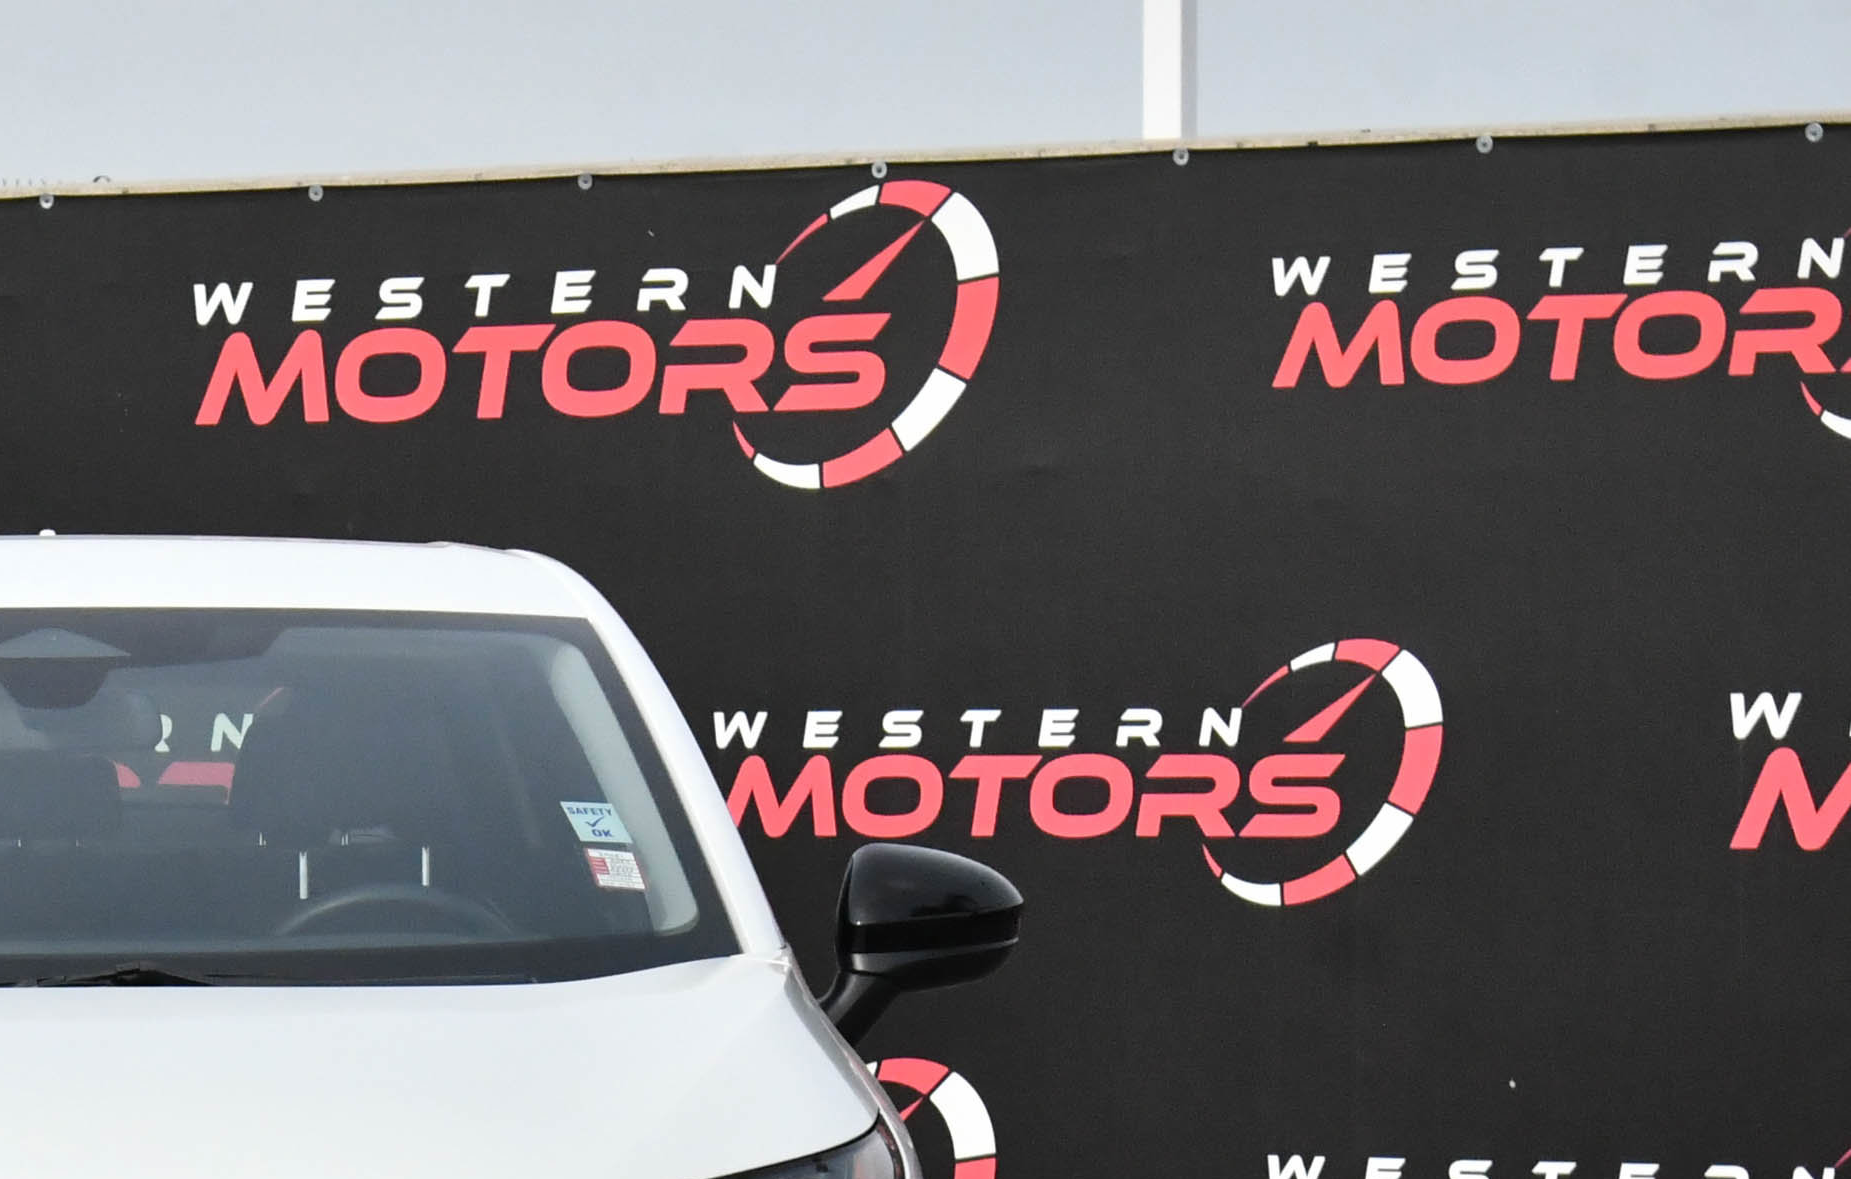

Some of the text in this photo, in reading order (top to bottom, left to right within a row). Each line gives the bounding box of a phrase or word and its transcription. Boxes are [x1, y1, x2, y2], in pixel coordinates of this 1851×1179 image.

[194, 264, 776, 325] WESTERN
[1272, 238, 1845, 297] WESTERN
[1272, 285, 1851, 388] MOTOR
[195, 313, 892, 424] MOTORS
[713, 709, 1242, 750] WESTERN
[725, 753, 1346, 839] MOTORS
[592, 829, 613, 837] OK
